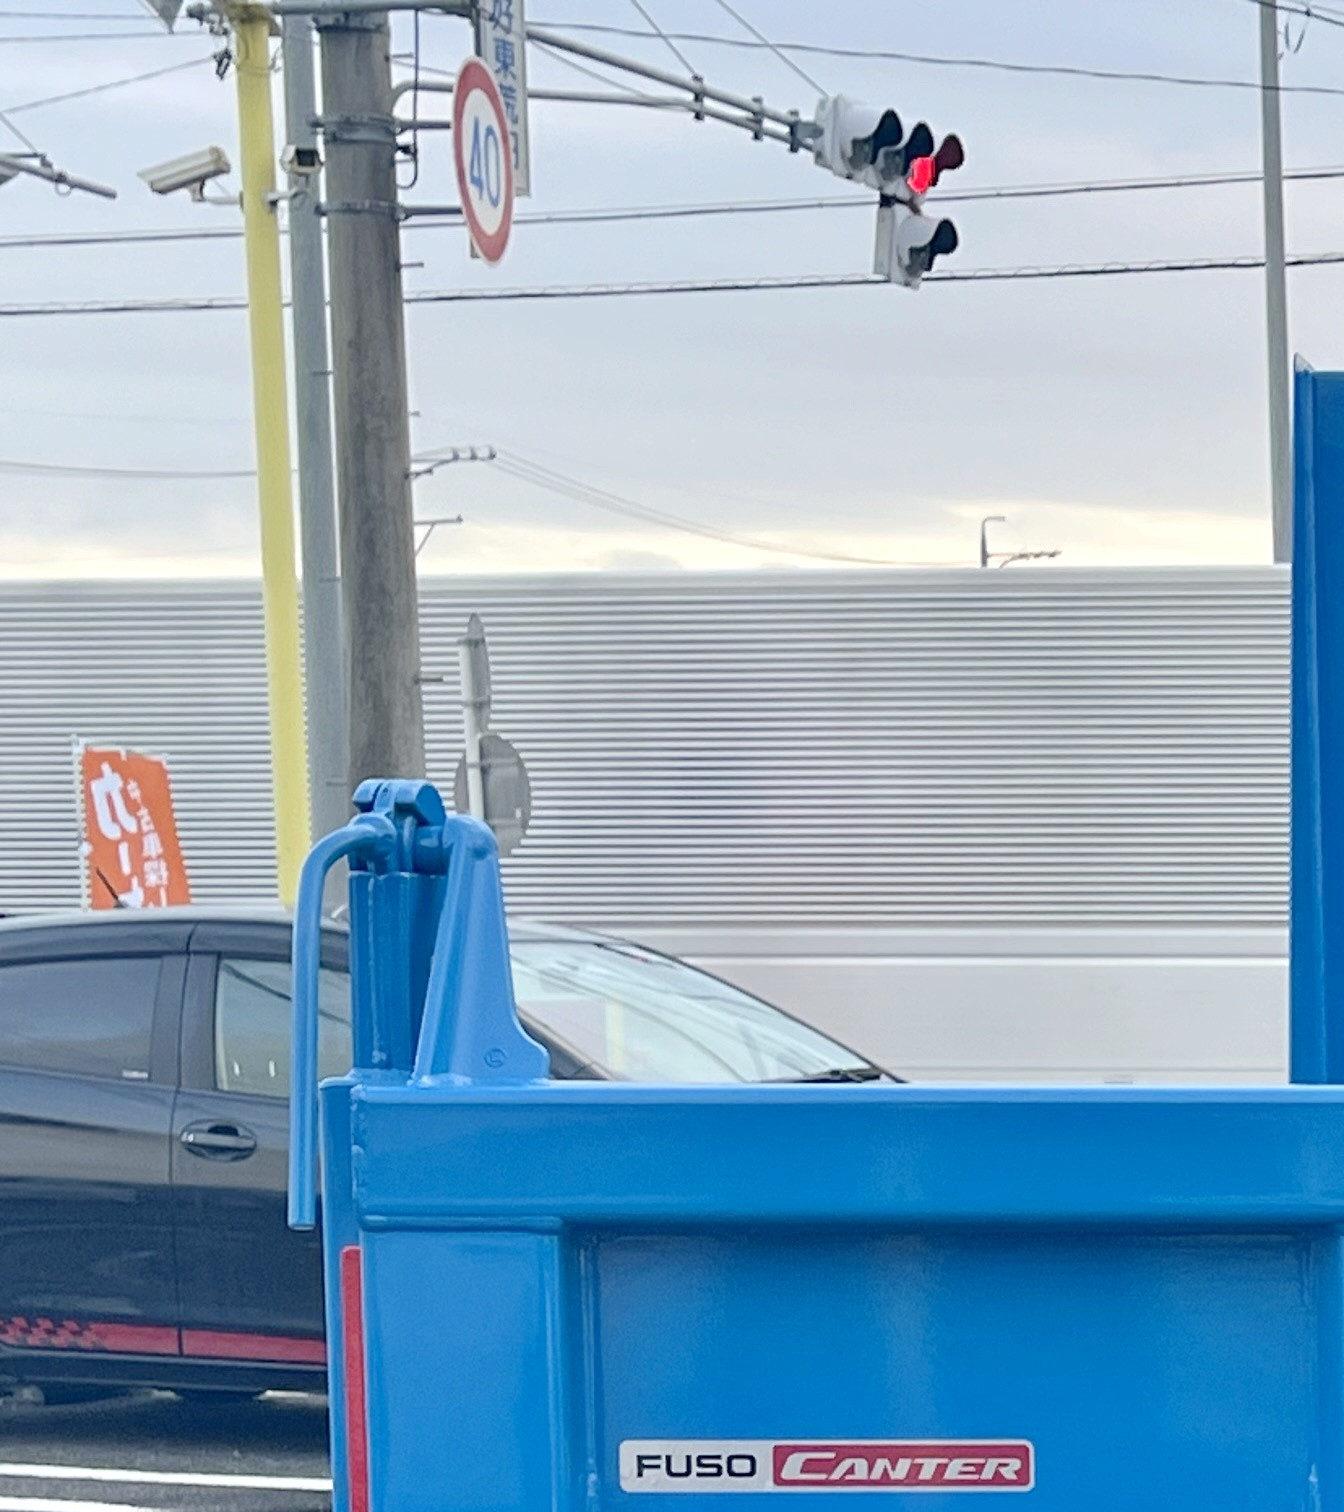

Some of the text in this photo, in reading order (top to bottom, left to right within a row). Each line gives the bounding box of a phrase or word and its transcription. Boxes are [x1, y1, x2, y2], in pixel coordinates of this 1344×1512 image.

[470, 116, 500, 209] 40
[636, 1451, 1024, 1482] FUSO CANTER
